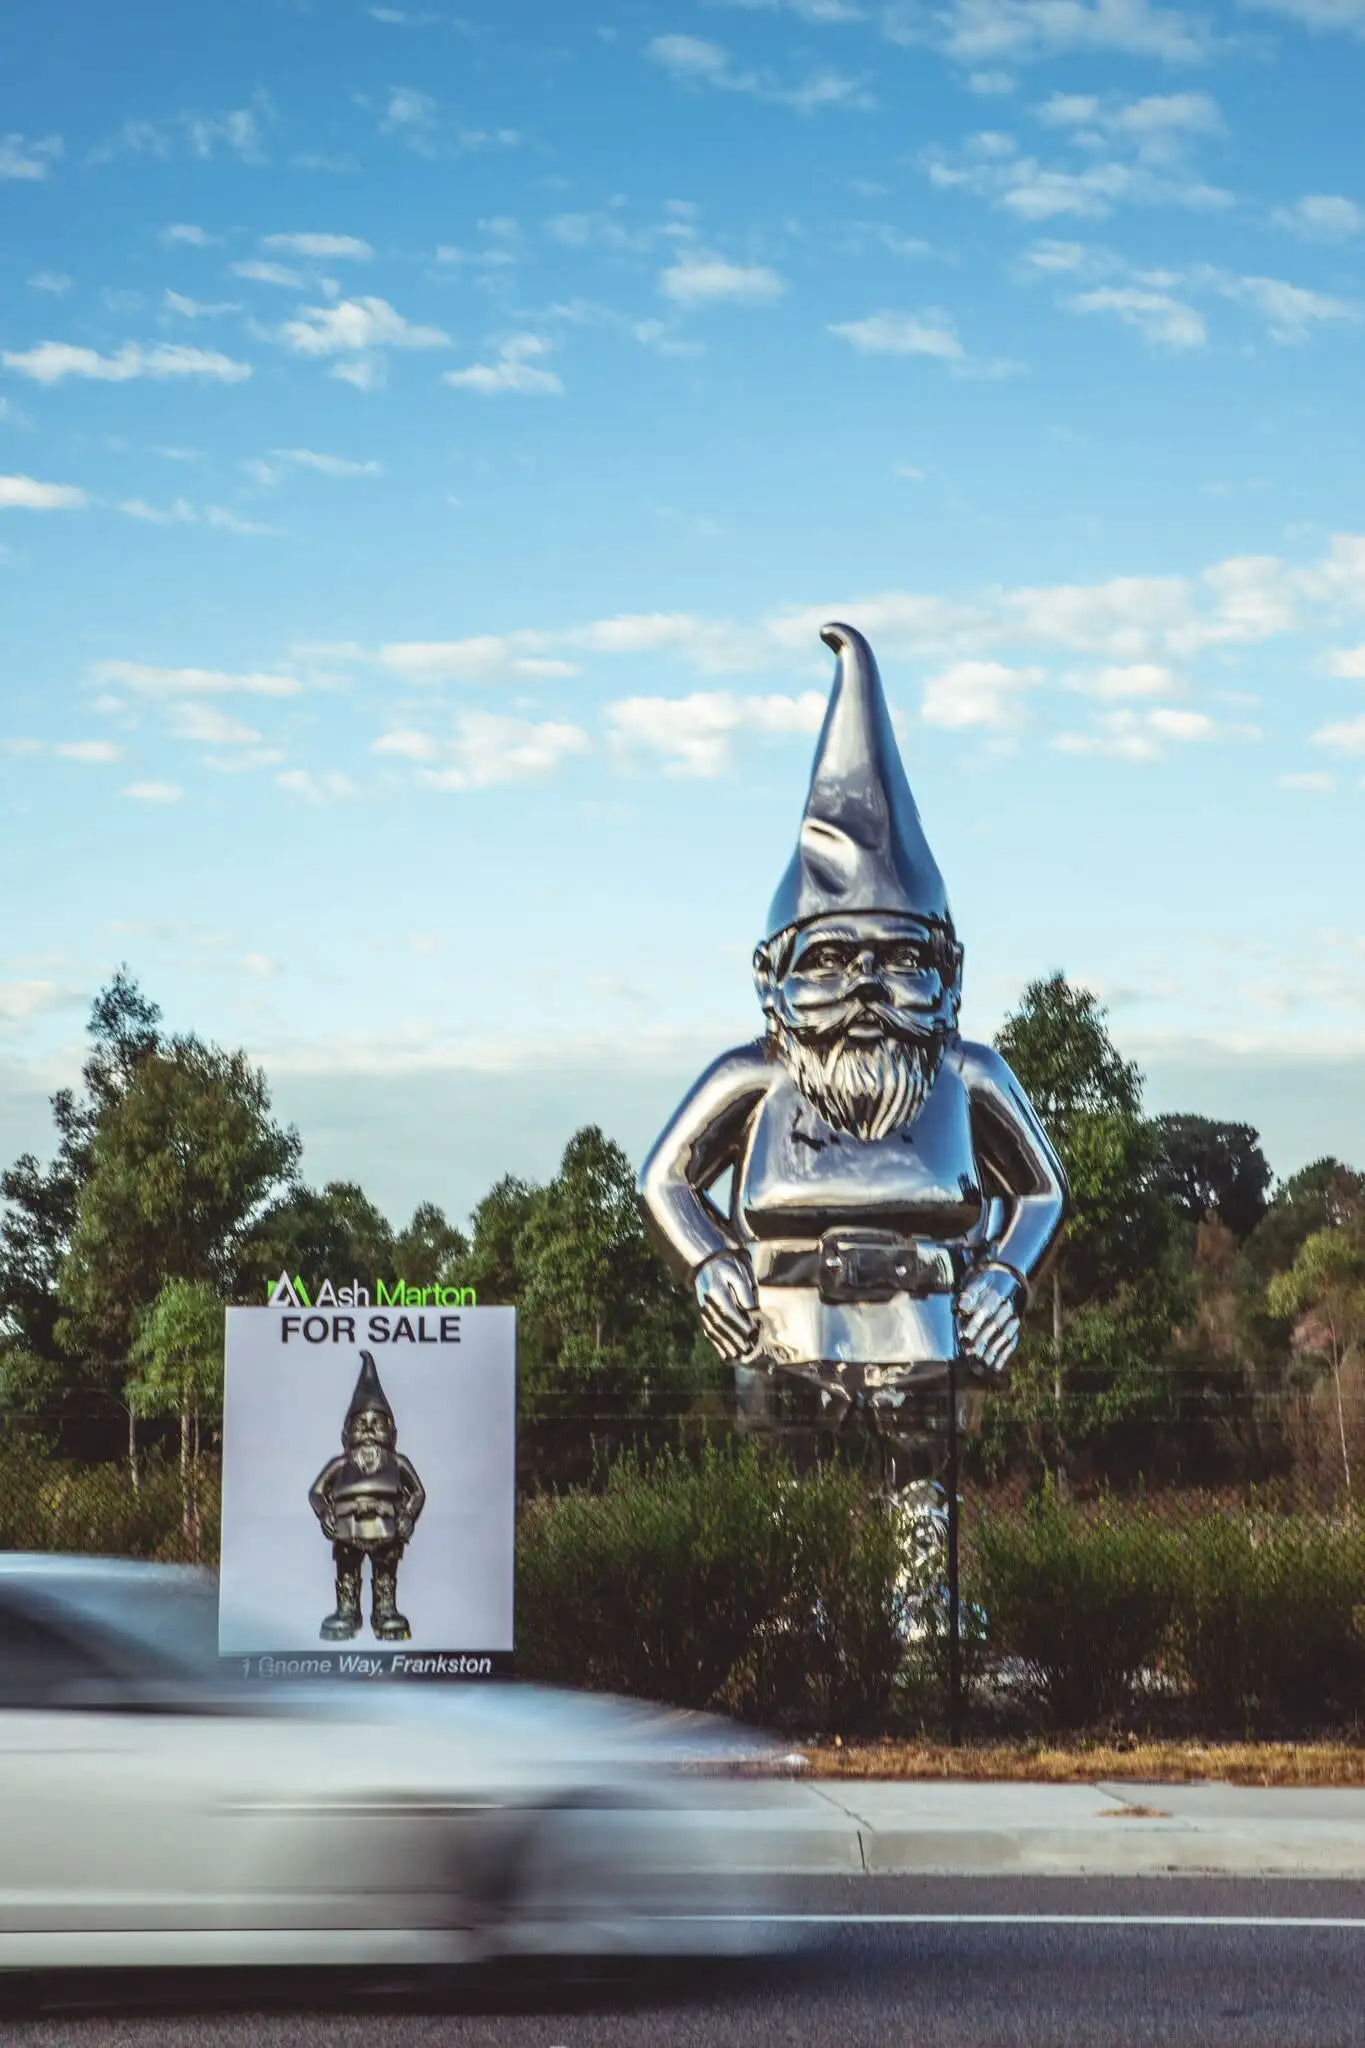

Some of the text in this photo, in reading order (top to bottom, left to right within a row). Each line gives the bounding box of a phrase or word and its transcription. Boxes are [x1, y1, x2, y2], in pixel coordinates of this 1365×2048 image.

[316, 1278, 477, 1307] Ash Marton
[281, 1316, 461, 1343] FOR SALE
[339, 1655, 384, 1677] Way,
[391, 1654, 492, 1674] Frankston
